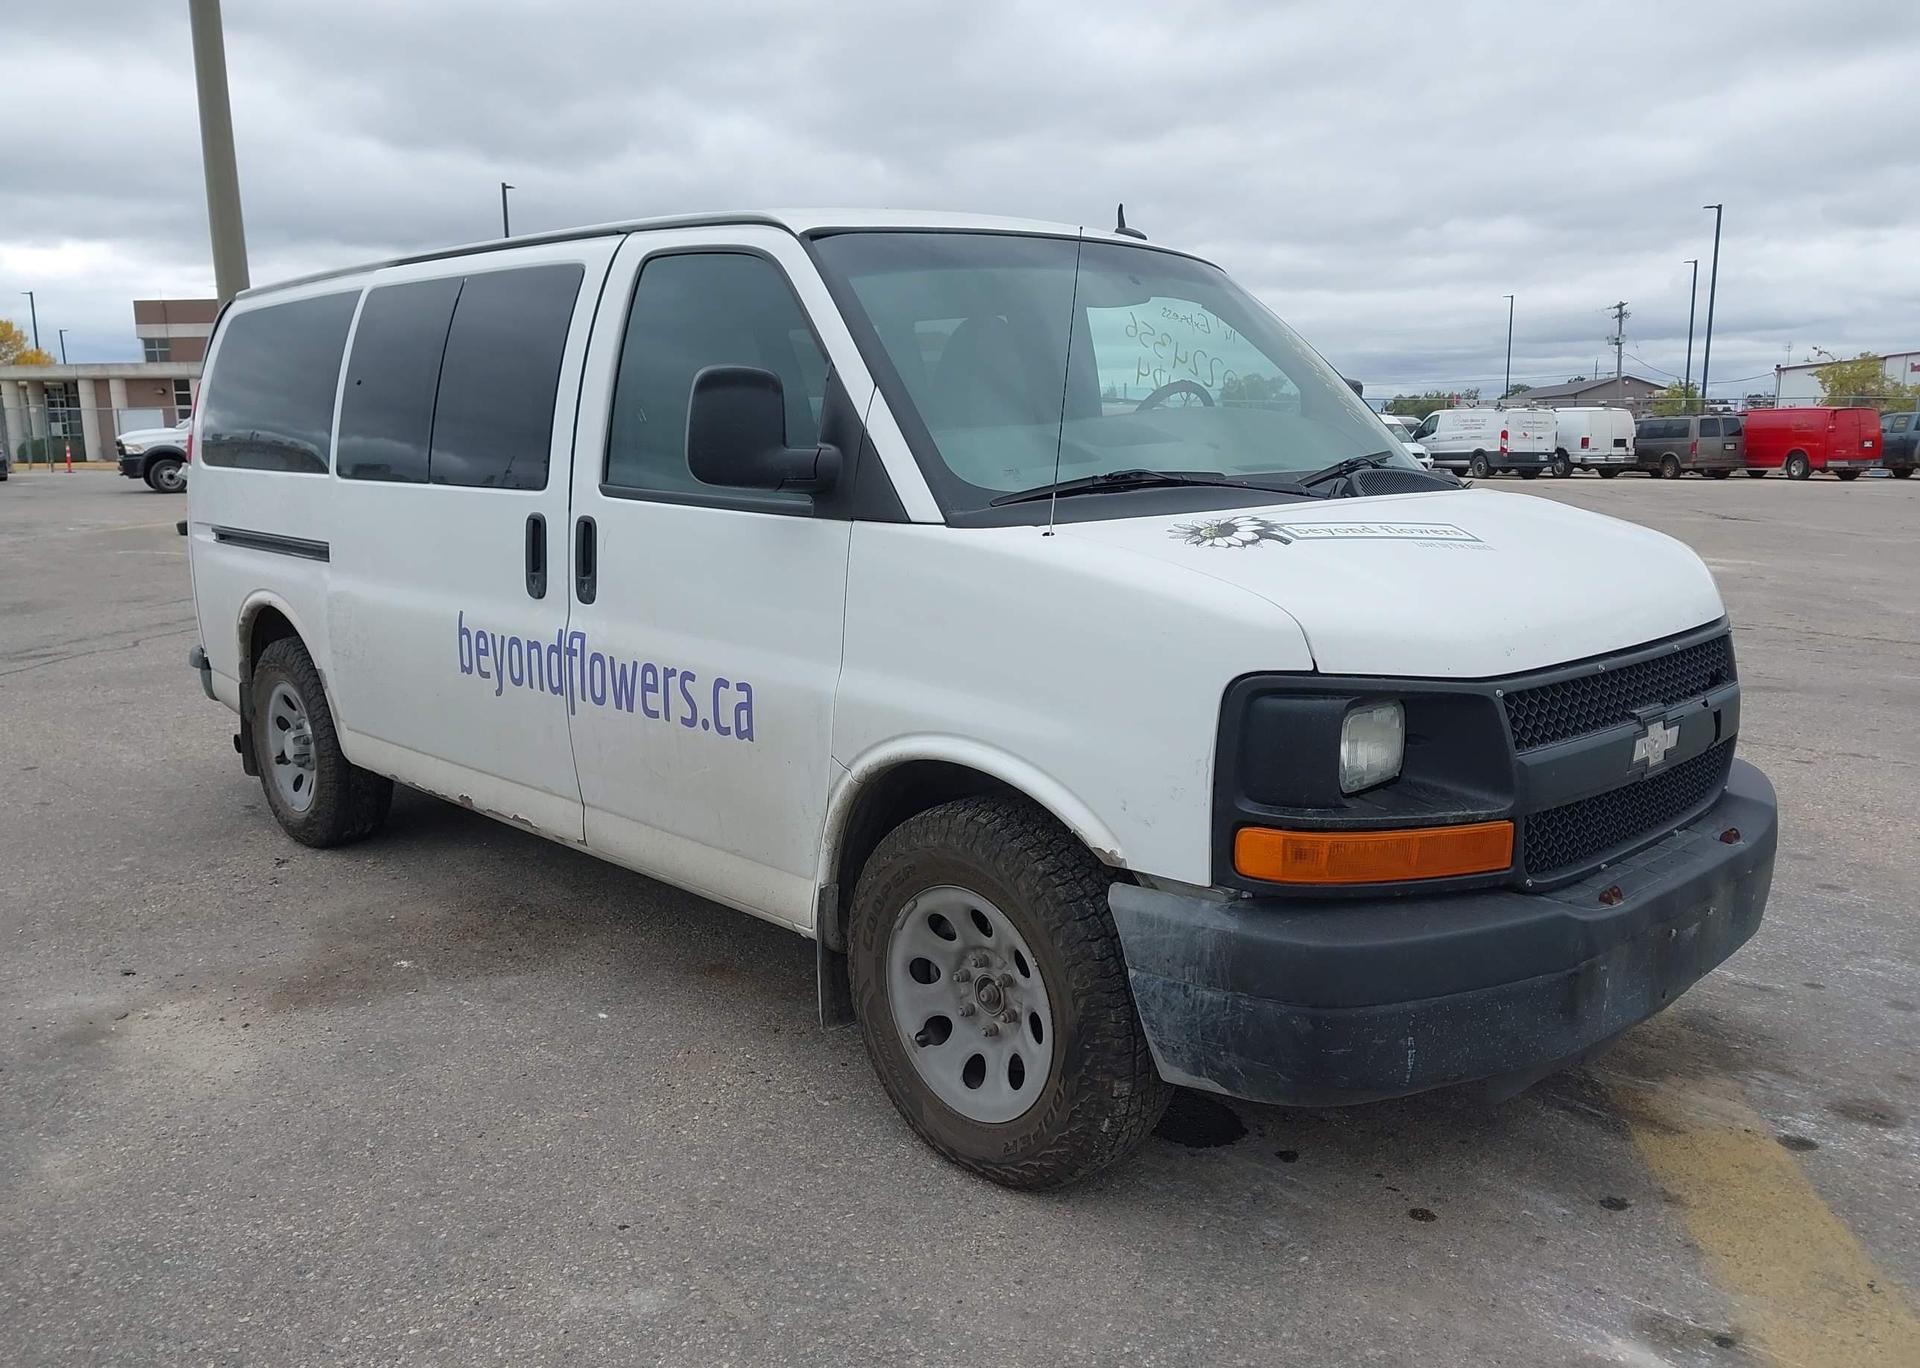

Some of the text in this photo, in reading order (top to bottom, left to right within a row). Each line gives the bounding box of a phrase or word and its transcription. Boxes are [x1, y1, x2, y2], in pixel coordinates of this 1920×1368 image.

[1289, 525, 1466, 536] beyond flowers
[458, 610, 755, 743] beyondflowers.ca
[863, 862, 917, 951] COOPER
